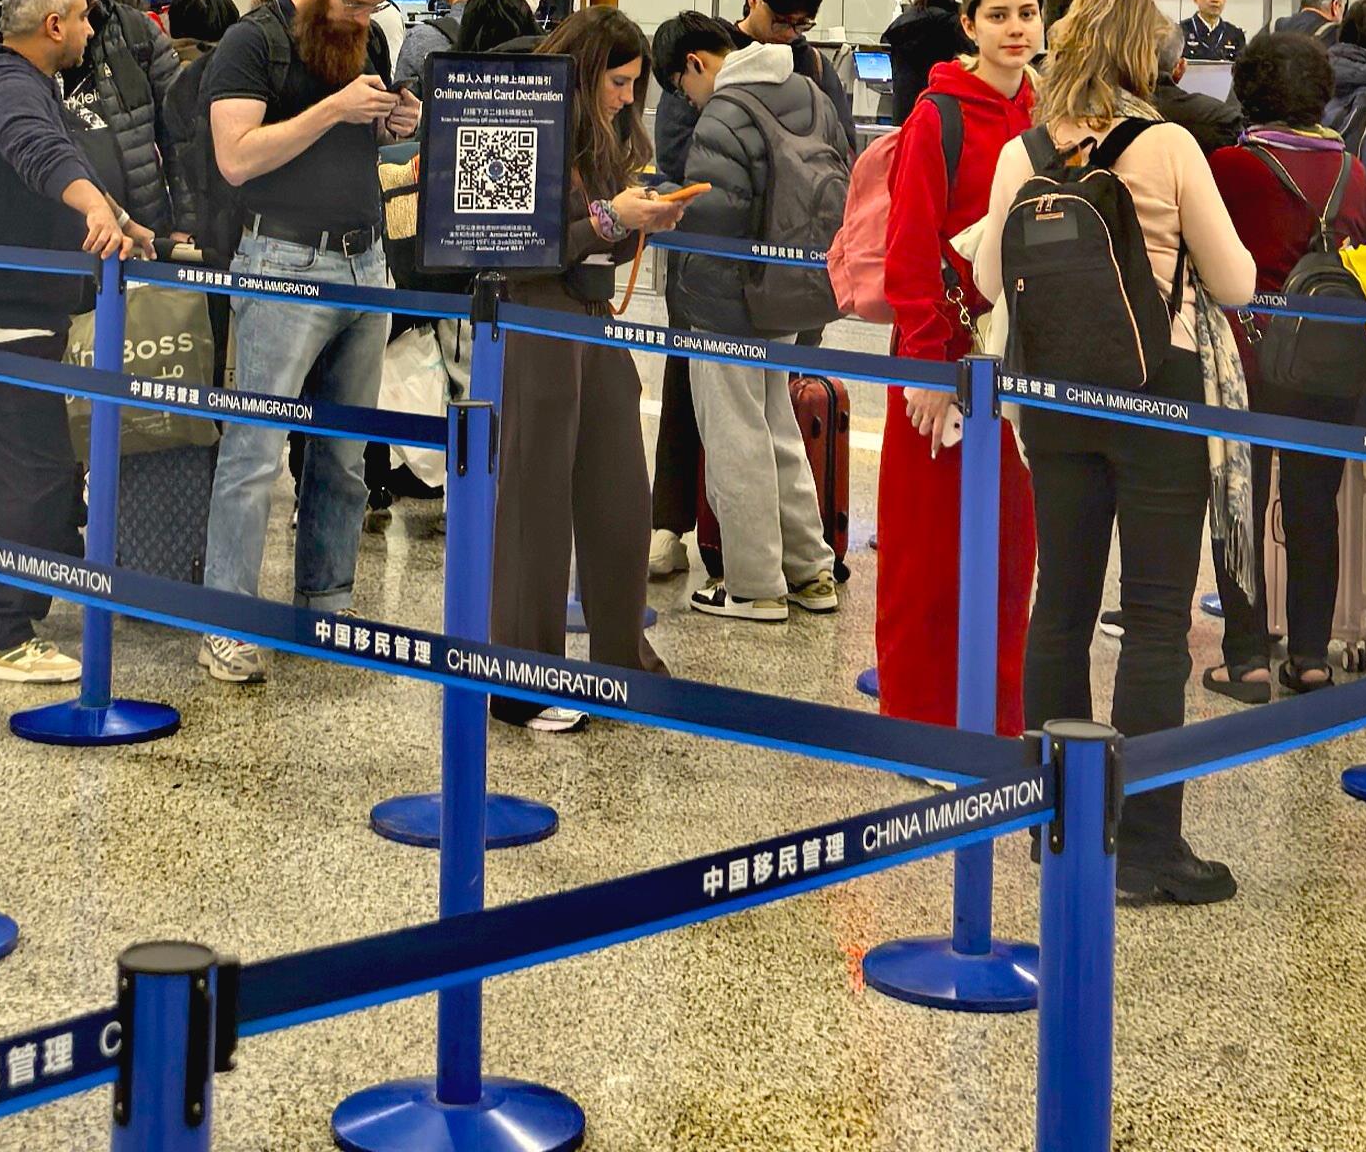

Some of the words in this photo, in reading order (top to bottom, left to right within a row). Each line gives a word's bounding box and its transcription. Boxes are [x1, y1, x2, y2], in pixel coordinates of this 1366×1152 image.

[434, 88, 463, 99] Online
[464, 88, 493, 100] Arrival
[494, 89, 515, 100] Card
[516, 90, 563, 102] Declaration
[751, 244, 804, 259] 中国移民管理
[810, 251, 827, 260] CHI
[178, 269, 232, 286] 中国移民管理
[238, 277, 264, 290] CHINA
[265, 280, 319, 297] IMMIGRATION
[1252, 294, 1287, 307] RATION
[123, 333, 194, 364] BOSS
[603, 324, 666, 346] 中国移民管理
[673, 334, 702, 349] CHINA
[703, 338, 767, 359] IMMIGRATION
[130, 380, 199, 405] 中国移民管理
[207, 392, 242, 410] CHINA
[242, 397, 314, 422] IMMIGRATION
[997, 377, 1057, 398] 移民管理
[1065, 388, 1104, 406] CHINA
[1106, 391, 1189, 421] IMMIGRATION
[16, 555, 113, 594] IMMIGRATION
[315, 619, 431, 666] 中国移民管理
[447, 648, 502, 680] CHINA
[505, 659, 627, 704] IMMIGRATION
[703, 831, 845, 898] 中国移民管理
[862, 812, 921, 853] CHINA
[925, 776, 1045, 832] IMMIGRATION
